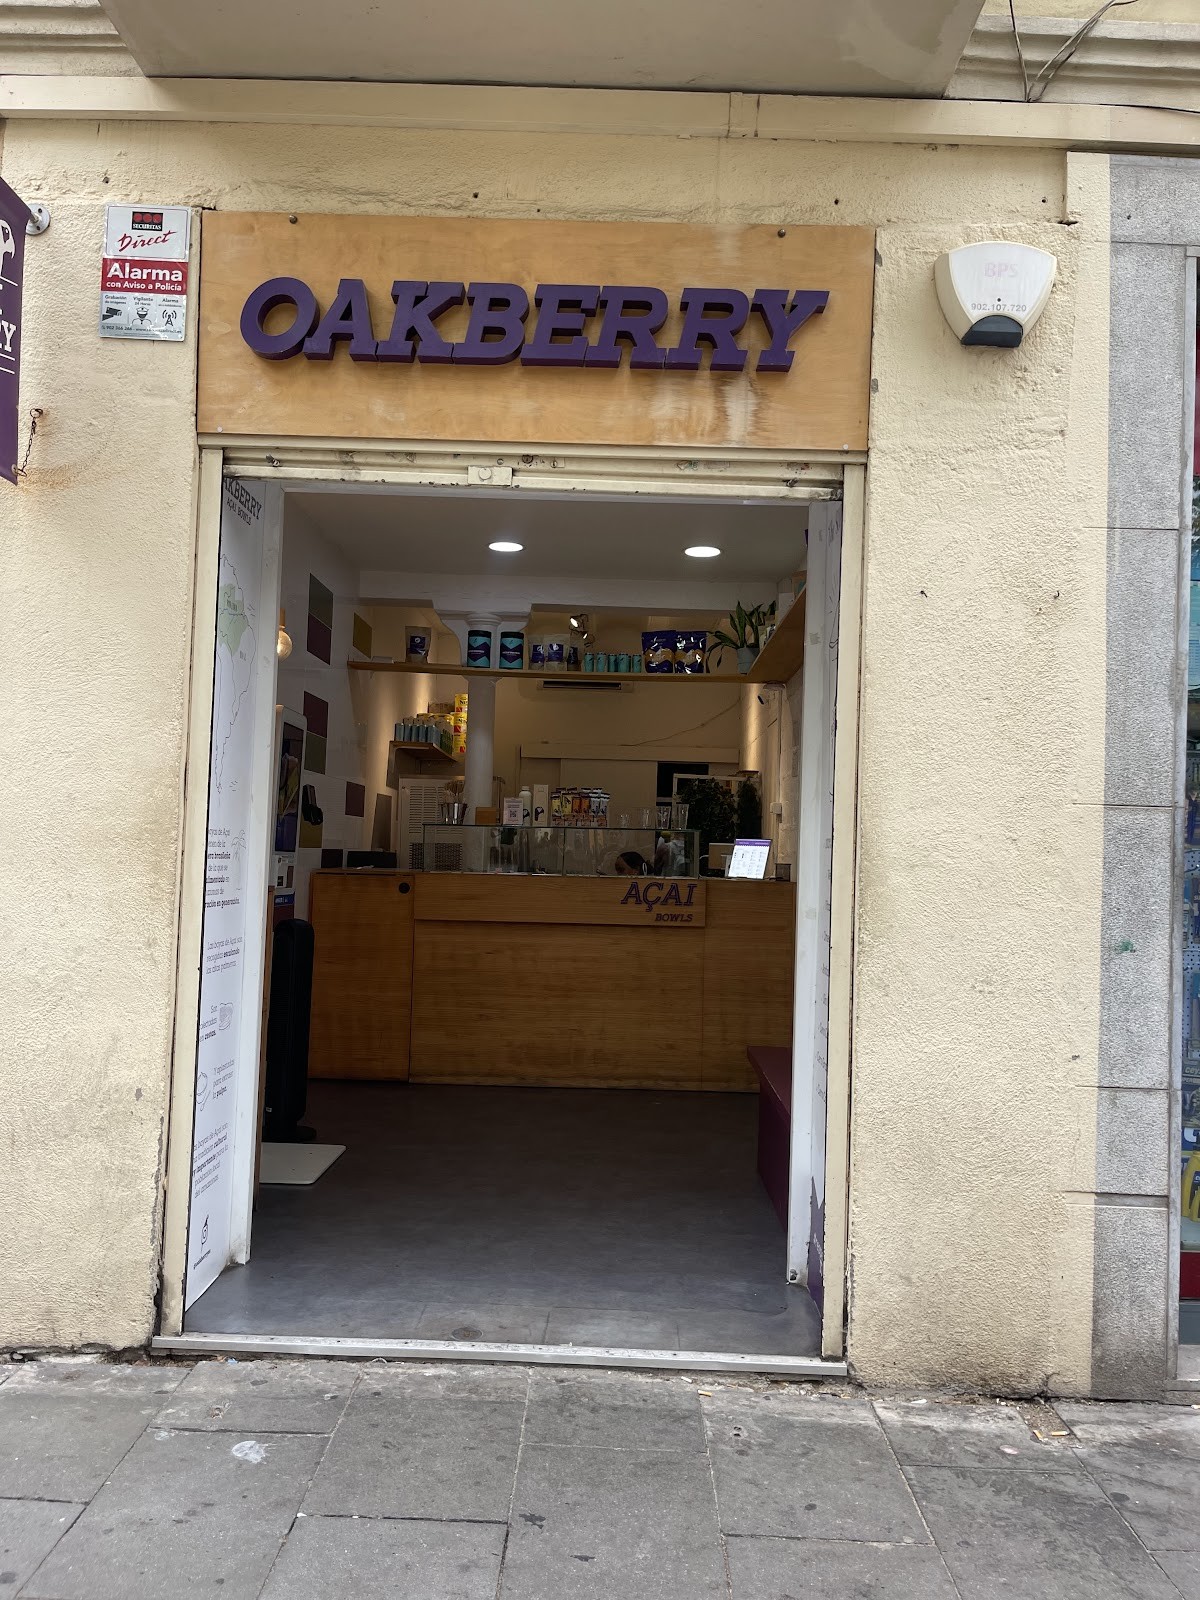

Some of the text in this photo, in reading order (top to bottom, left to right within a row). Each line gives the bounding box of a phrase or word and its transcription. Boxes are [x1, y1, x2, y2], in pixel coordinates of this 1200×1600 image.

[118, 230, 177, 252] Direct
[107, 262, 183, 281] Alarma
[984, 262, 1019, 278] BPS
[123, 281, 146, 289] Aviso
[155, 282, 182, 291] Policía
[971, 302, 1027, 312] 902.107.720
[239, 275, 830, 372] OAKBERRY
[620, 881, 697, 912] AÇAI
[655, 913, 695, 923] BOWLS
